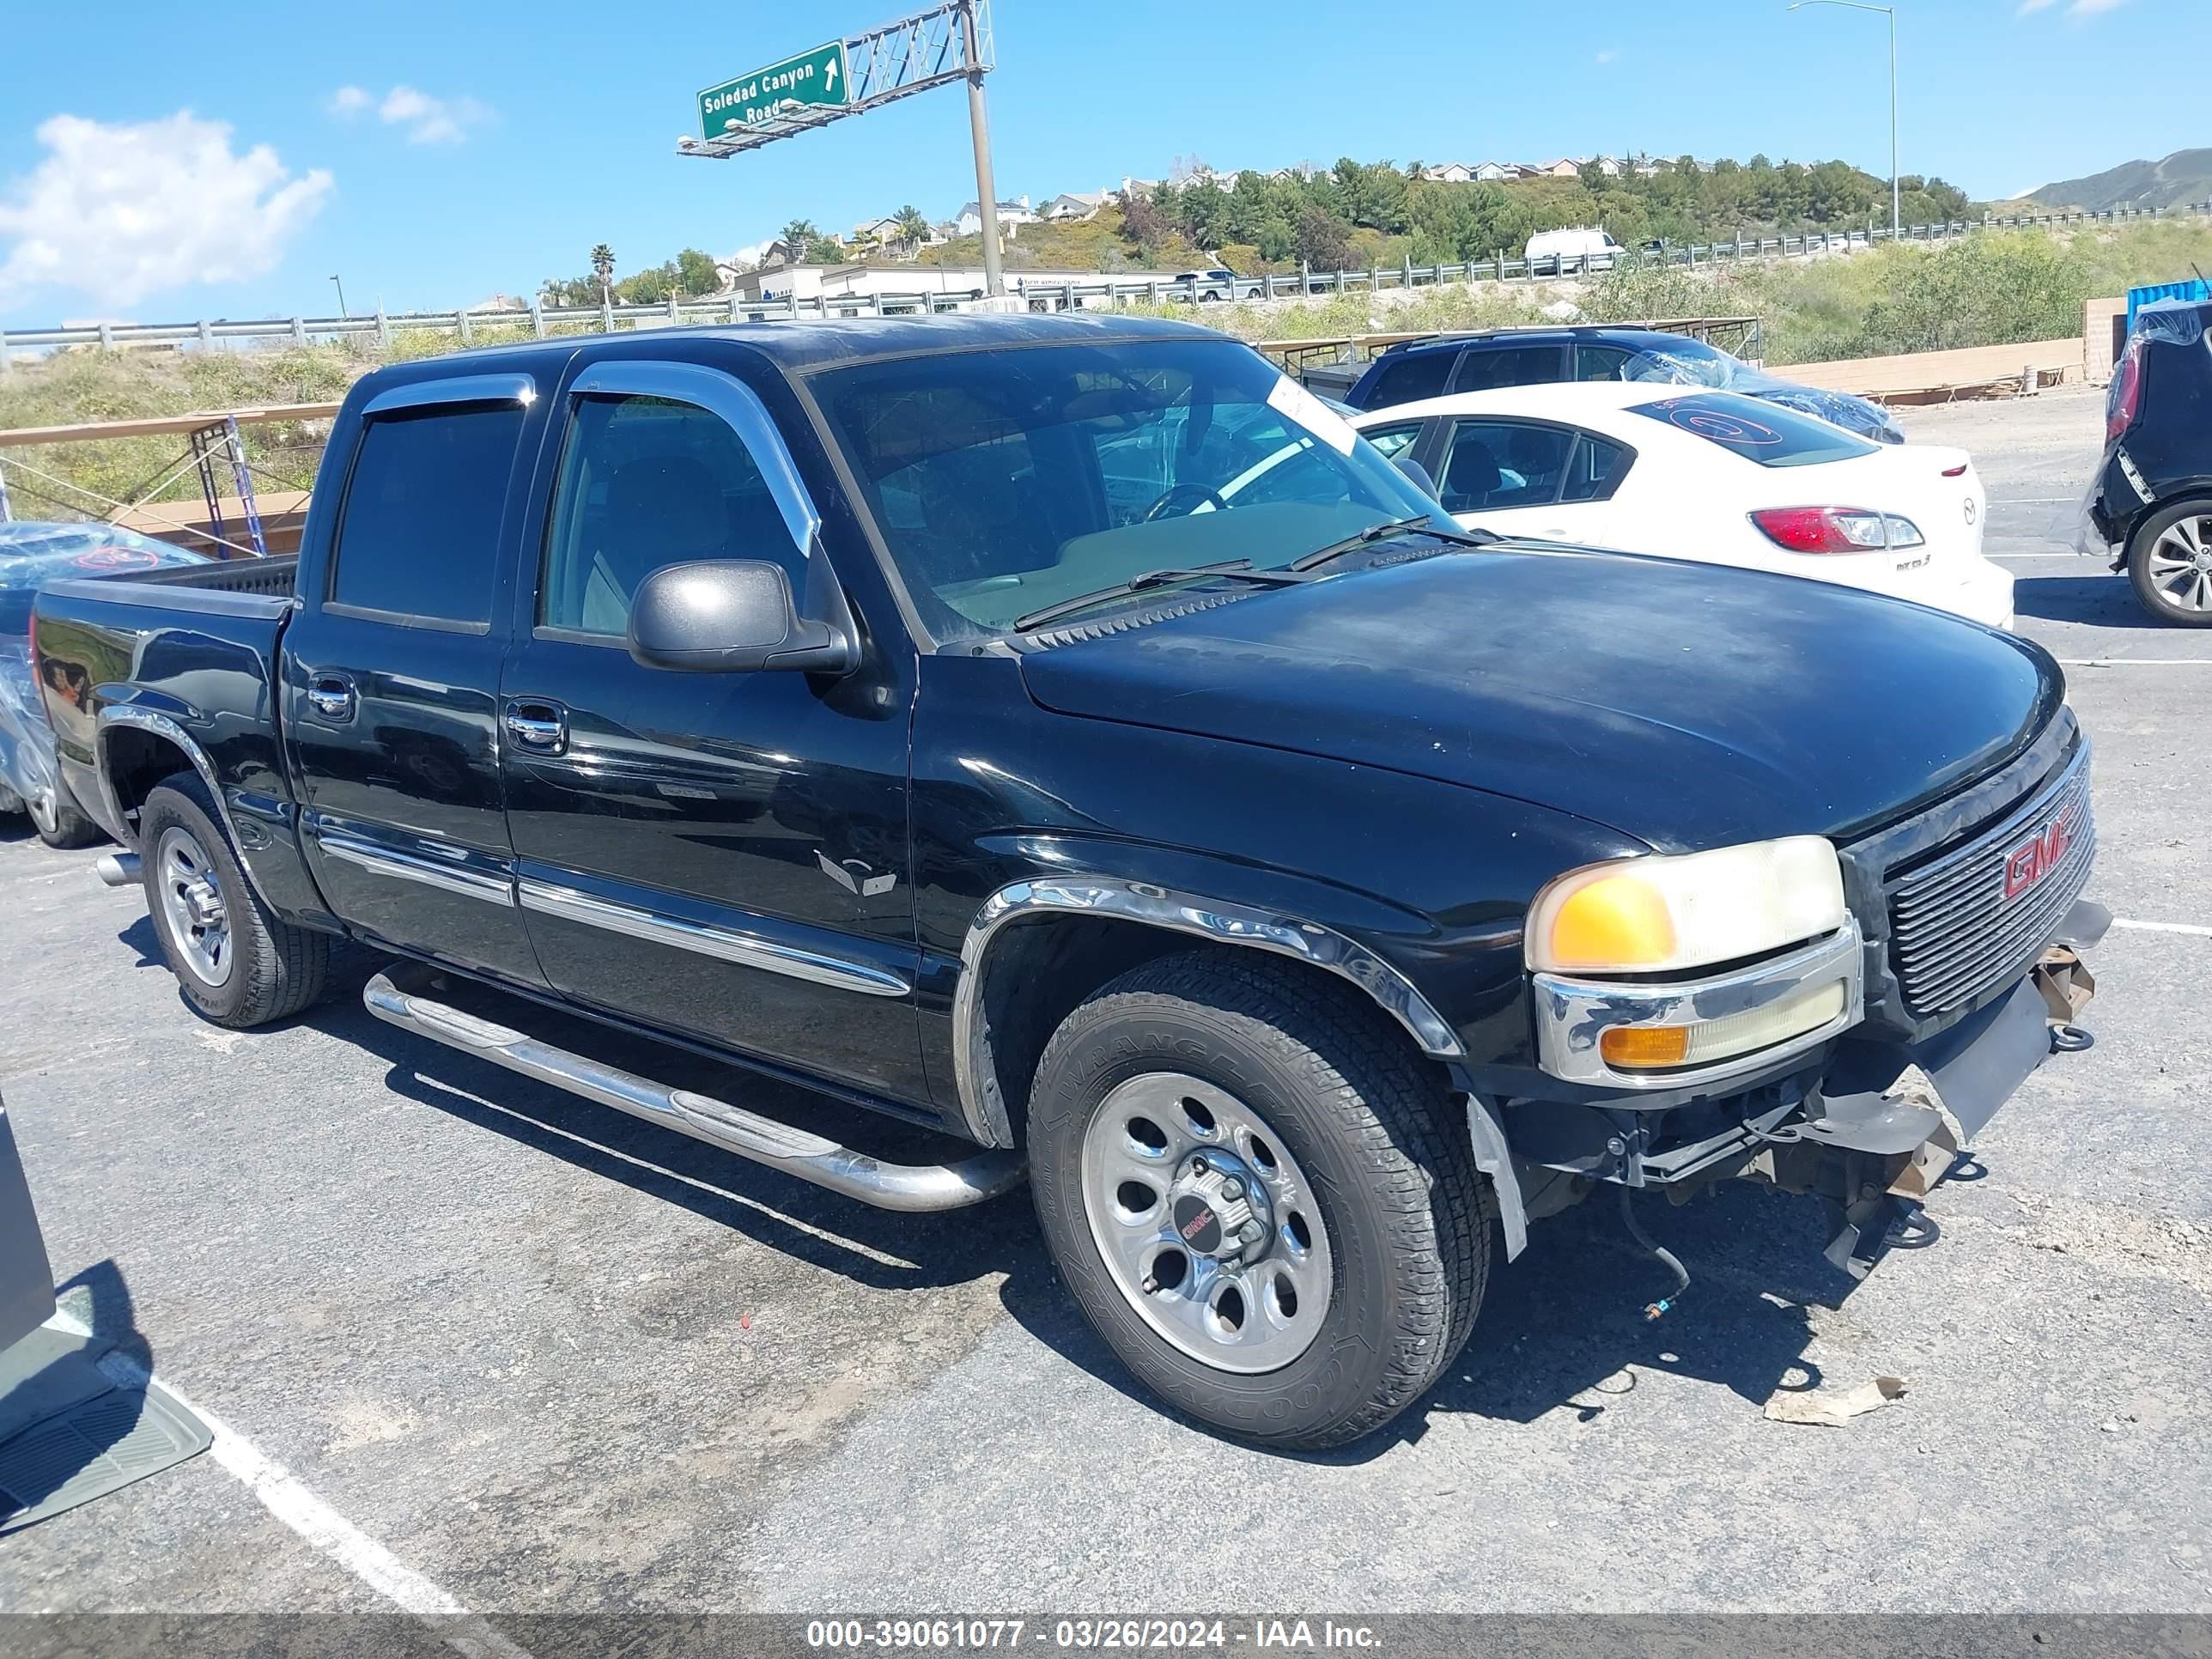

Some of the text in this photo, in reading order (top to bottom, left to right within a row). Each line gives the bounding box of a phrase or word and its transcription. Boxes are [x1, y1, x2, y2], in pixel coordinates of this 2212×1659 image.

[704, 64, 814, 114] Soledad Canyon
[746, 99, 781, 125] Road
[1058, 1033, 1312, 1147] WRANGLER
[1182, 1207, 1215, 1240] GMC
[1083, 1277, 1345, 1419] GOODYEAR
